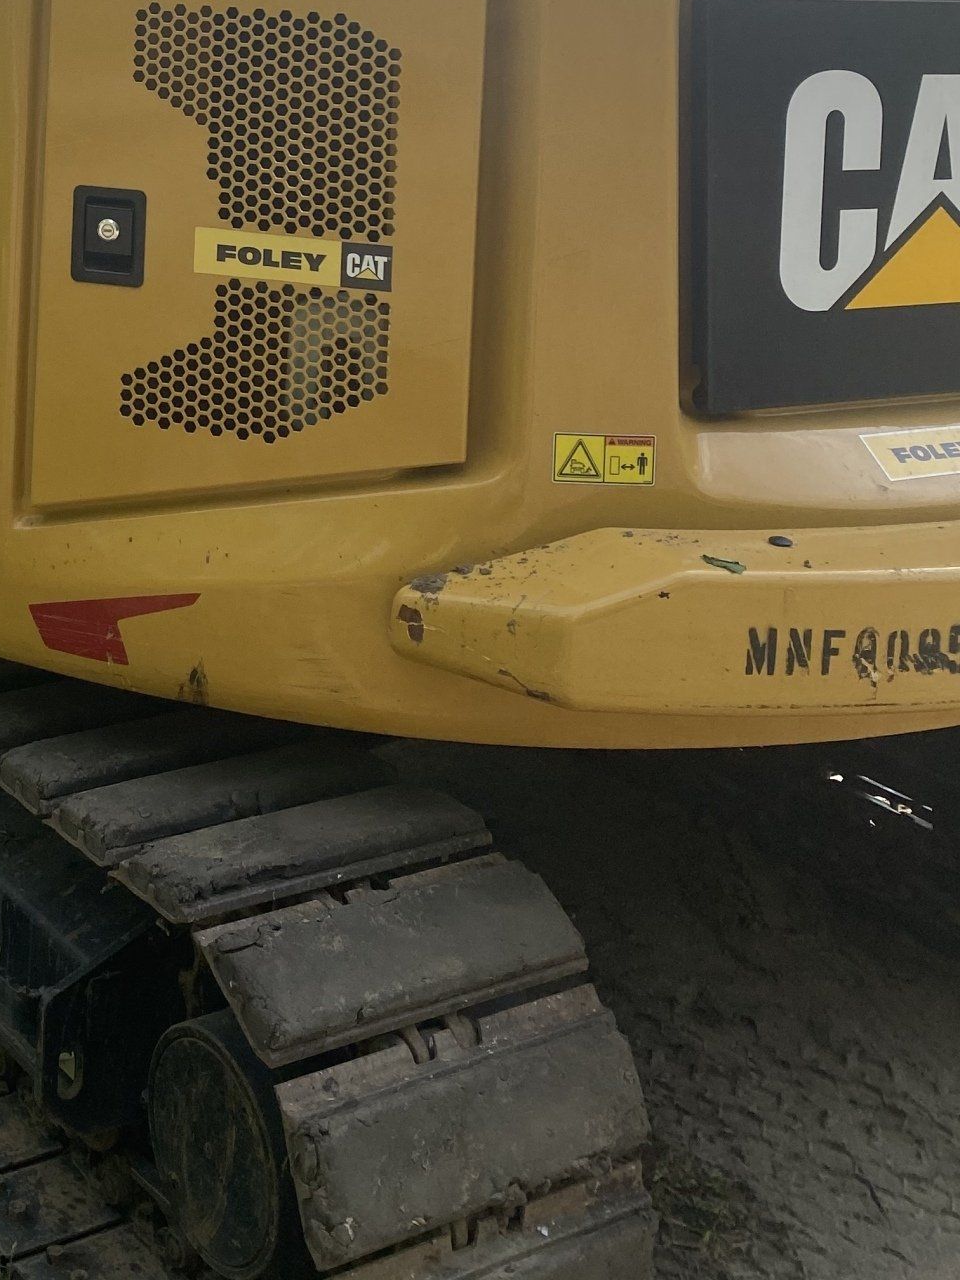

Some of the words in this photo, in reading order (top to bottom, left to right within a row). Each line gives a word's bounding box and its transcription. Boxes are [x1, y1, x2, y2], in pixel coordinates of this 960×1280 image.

[779, 69, 960, 312] CA
[217, 244, 327, 272] FOLEY
[346, 252, 388, 281] CAT
[890, 441, 960, 464] FOLE
